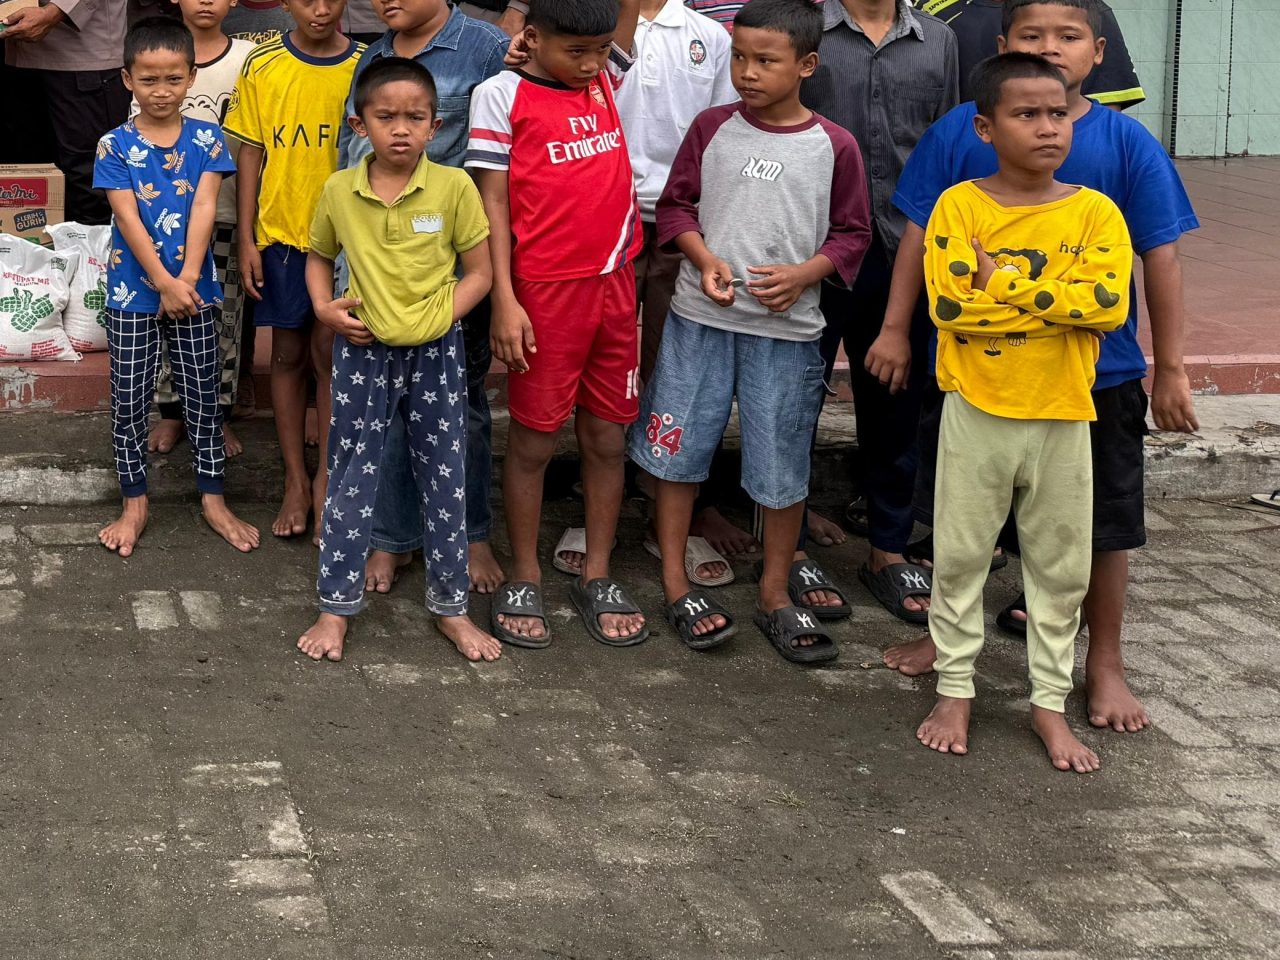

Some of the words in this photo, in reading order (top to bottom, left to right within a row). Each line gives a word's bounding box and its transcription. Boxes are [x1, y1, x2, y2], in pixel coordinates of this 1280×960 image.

[568, 114, 597, 134] Fly
[16, 217, 45, 230] GURIH
[646, 412, 684, 456] 84
